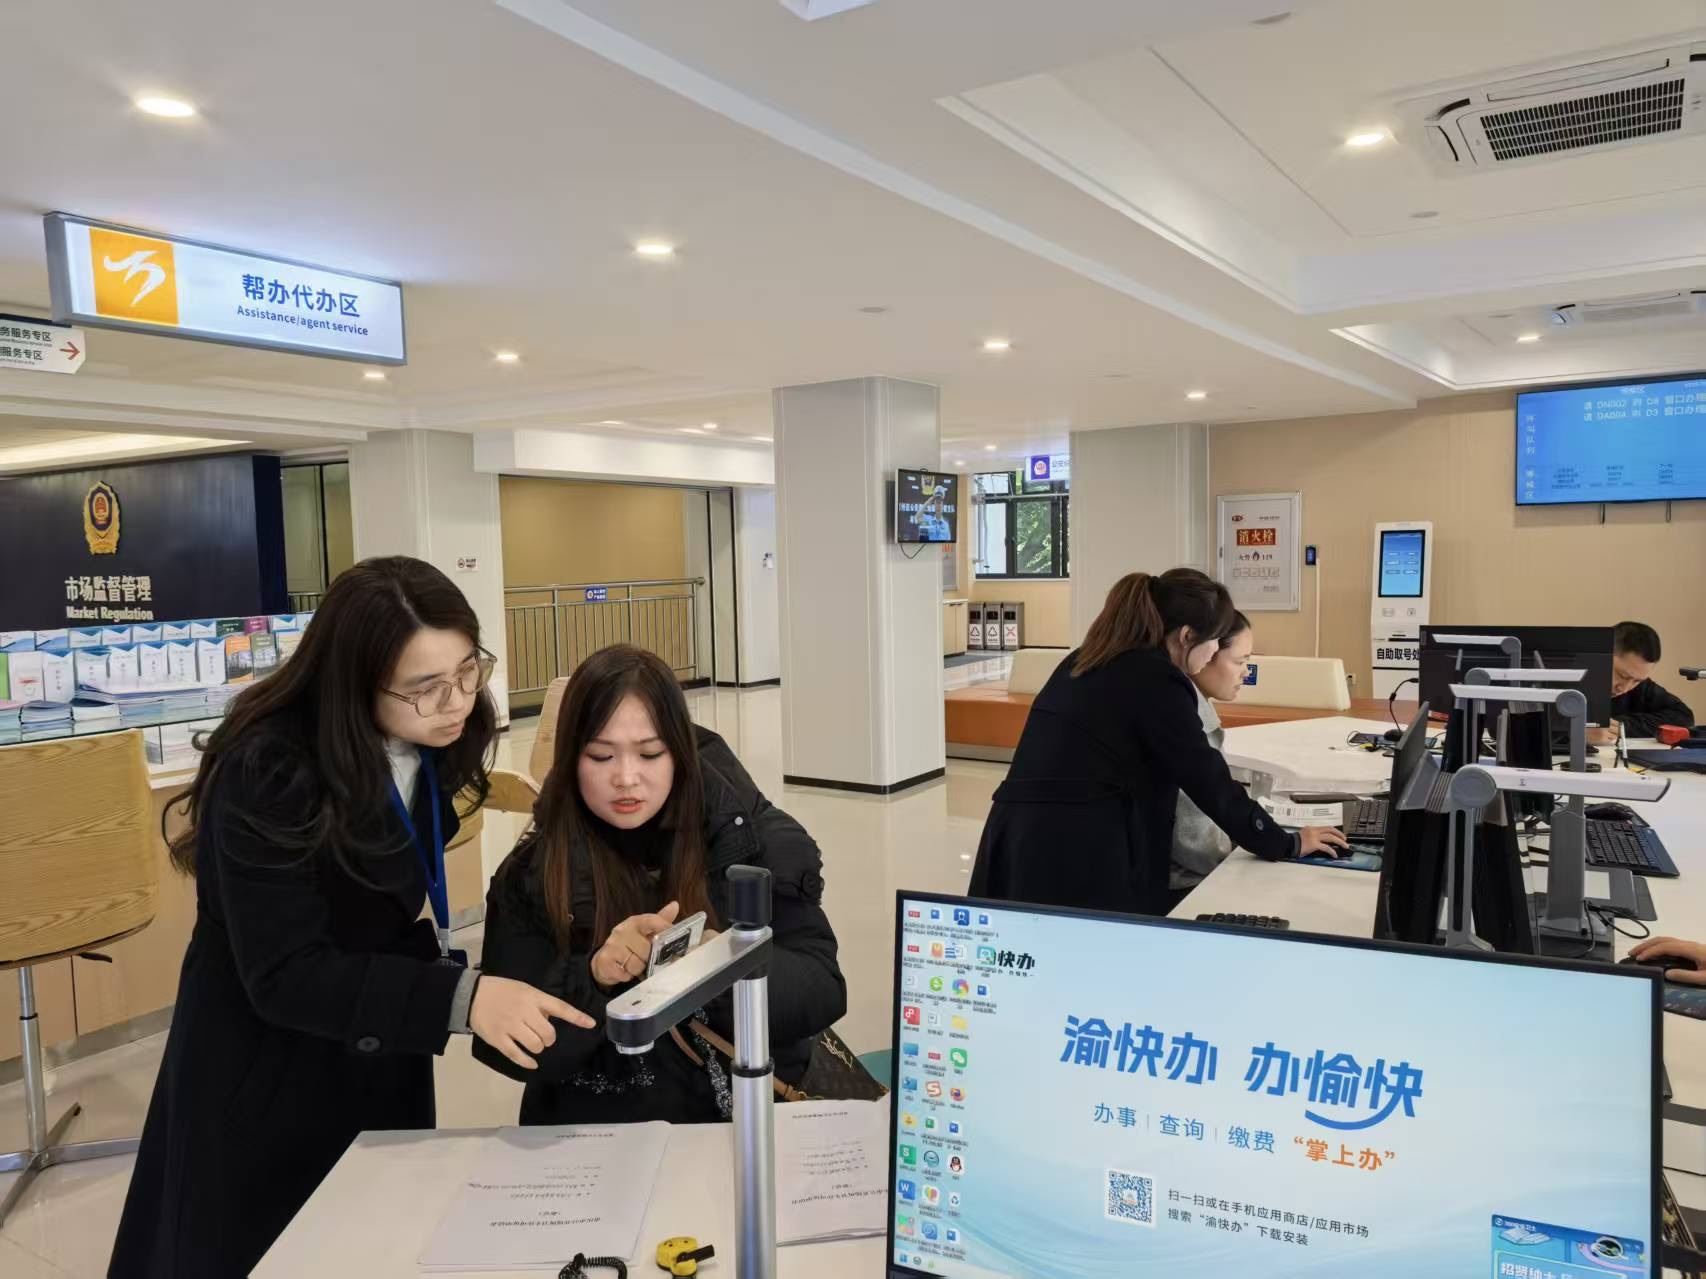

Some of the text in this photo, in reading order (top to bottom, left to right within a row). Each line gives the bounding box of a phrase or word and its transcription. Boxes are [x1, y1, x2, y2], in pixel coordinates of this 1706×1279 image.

[241, 273, 360, 318] 帮办代办区
[237, 305, 369, 336] Assistance/agent service
[1239, 529, 1274, 543] 消火栓
[65, 575, 152, 602] 市场监督管理
[66, 606, 153, 621] Market Regulation
[993, 949, 1035, 969] 快办
[1060, 1015, 1424, 1131] 渝快办 办愉快
[1093, 1103, 1137, 1128] 办事
[1159, 1114, 1204, 1141] 查询
[1228, 1125, 1275, 1153] 缴费
[1168, 1188, 1369, 1238] 扫一扫或在手机应用商店/应用市场
